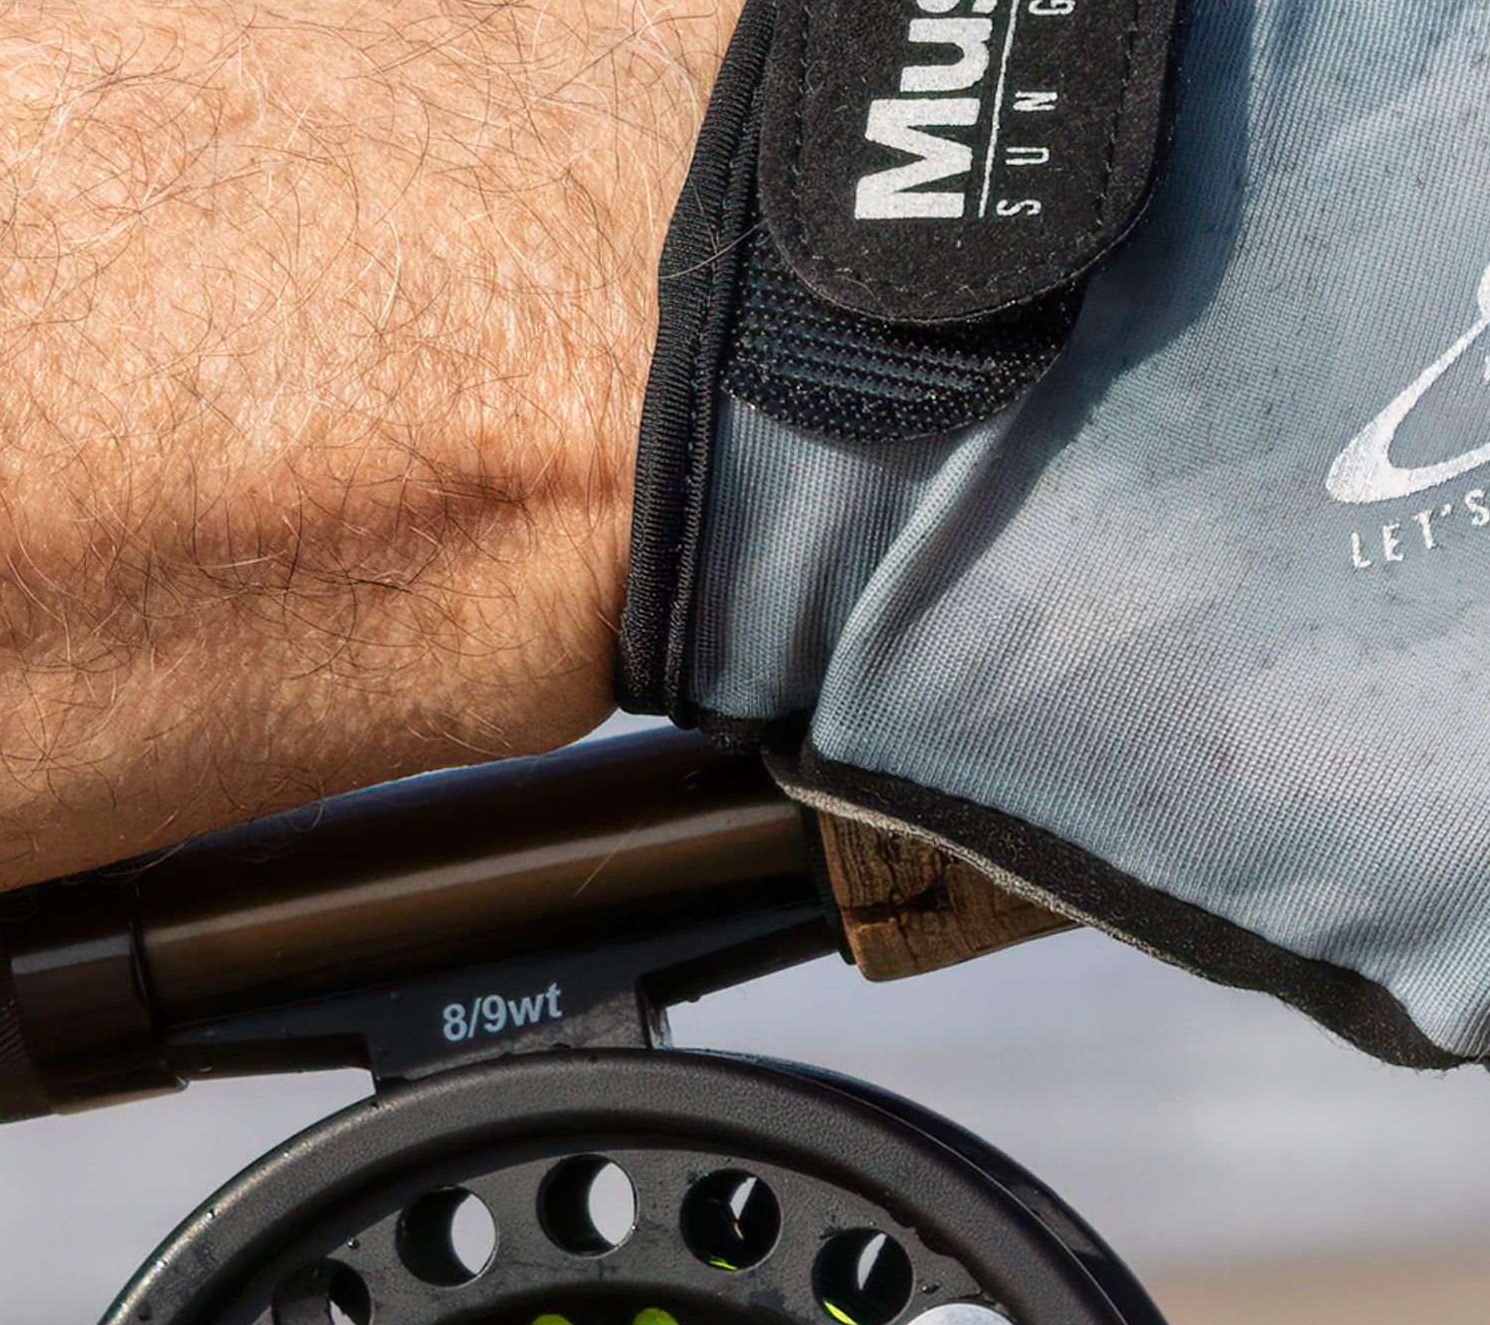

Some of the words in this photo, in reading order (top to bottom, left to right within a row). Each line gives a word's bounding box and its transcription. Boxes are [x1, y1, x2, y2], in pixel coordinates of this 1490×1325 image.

[996, 90, 1059, 217] SUN
[1350, 488, 1490, 569] LET'S
[442, 982, 563, 1042] 8/9wt
